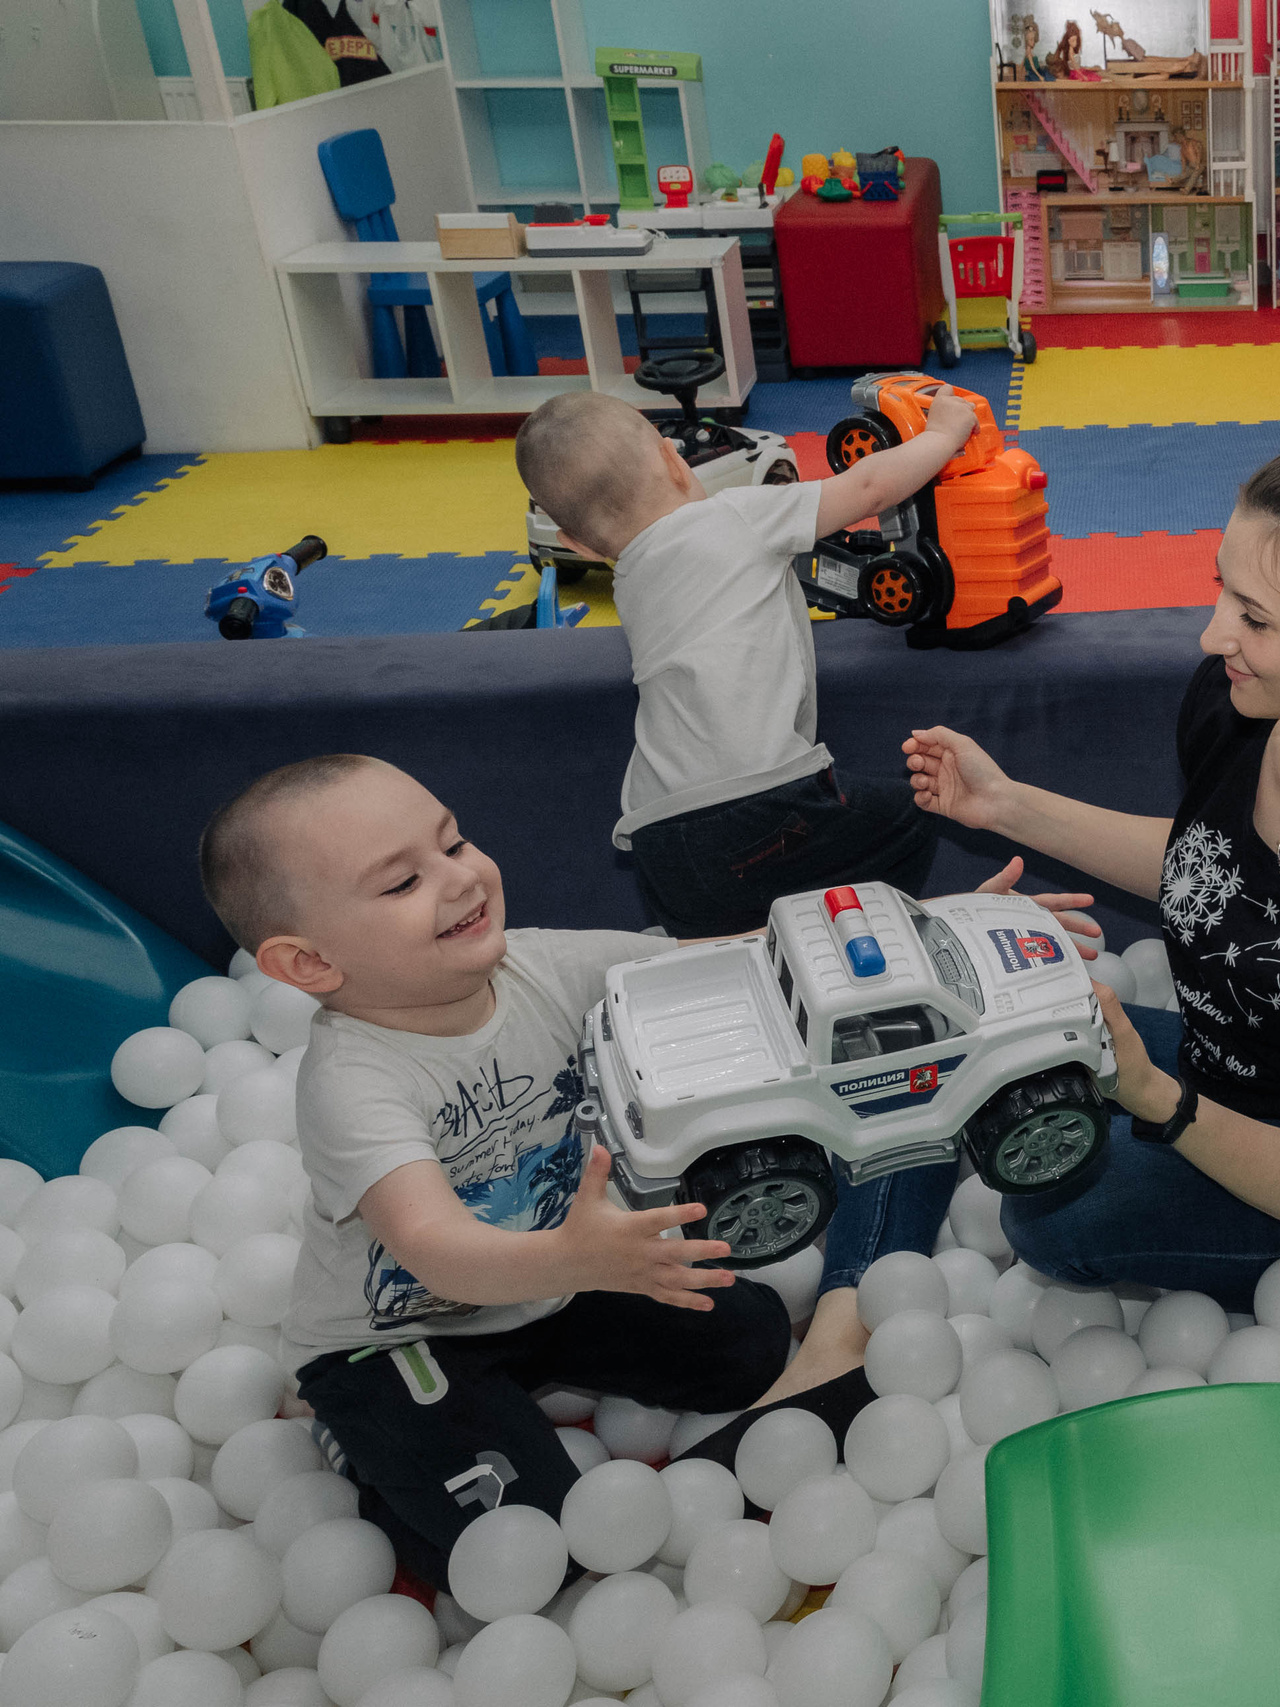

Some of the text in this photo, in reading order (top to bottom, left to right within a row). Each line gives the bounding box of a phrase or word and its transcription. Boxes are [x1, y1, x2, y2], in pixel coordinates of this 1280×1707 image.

[613, 64, 674, 76] SUPERMARKET
[996, 930, 1022, 971] ПОЛИЦИЯ
[839, 1071, 905, 1094] ПОЛИЦИЯ
